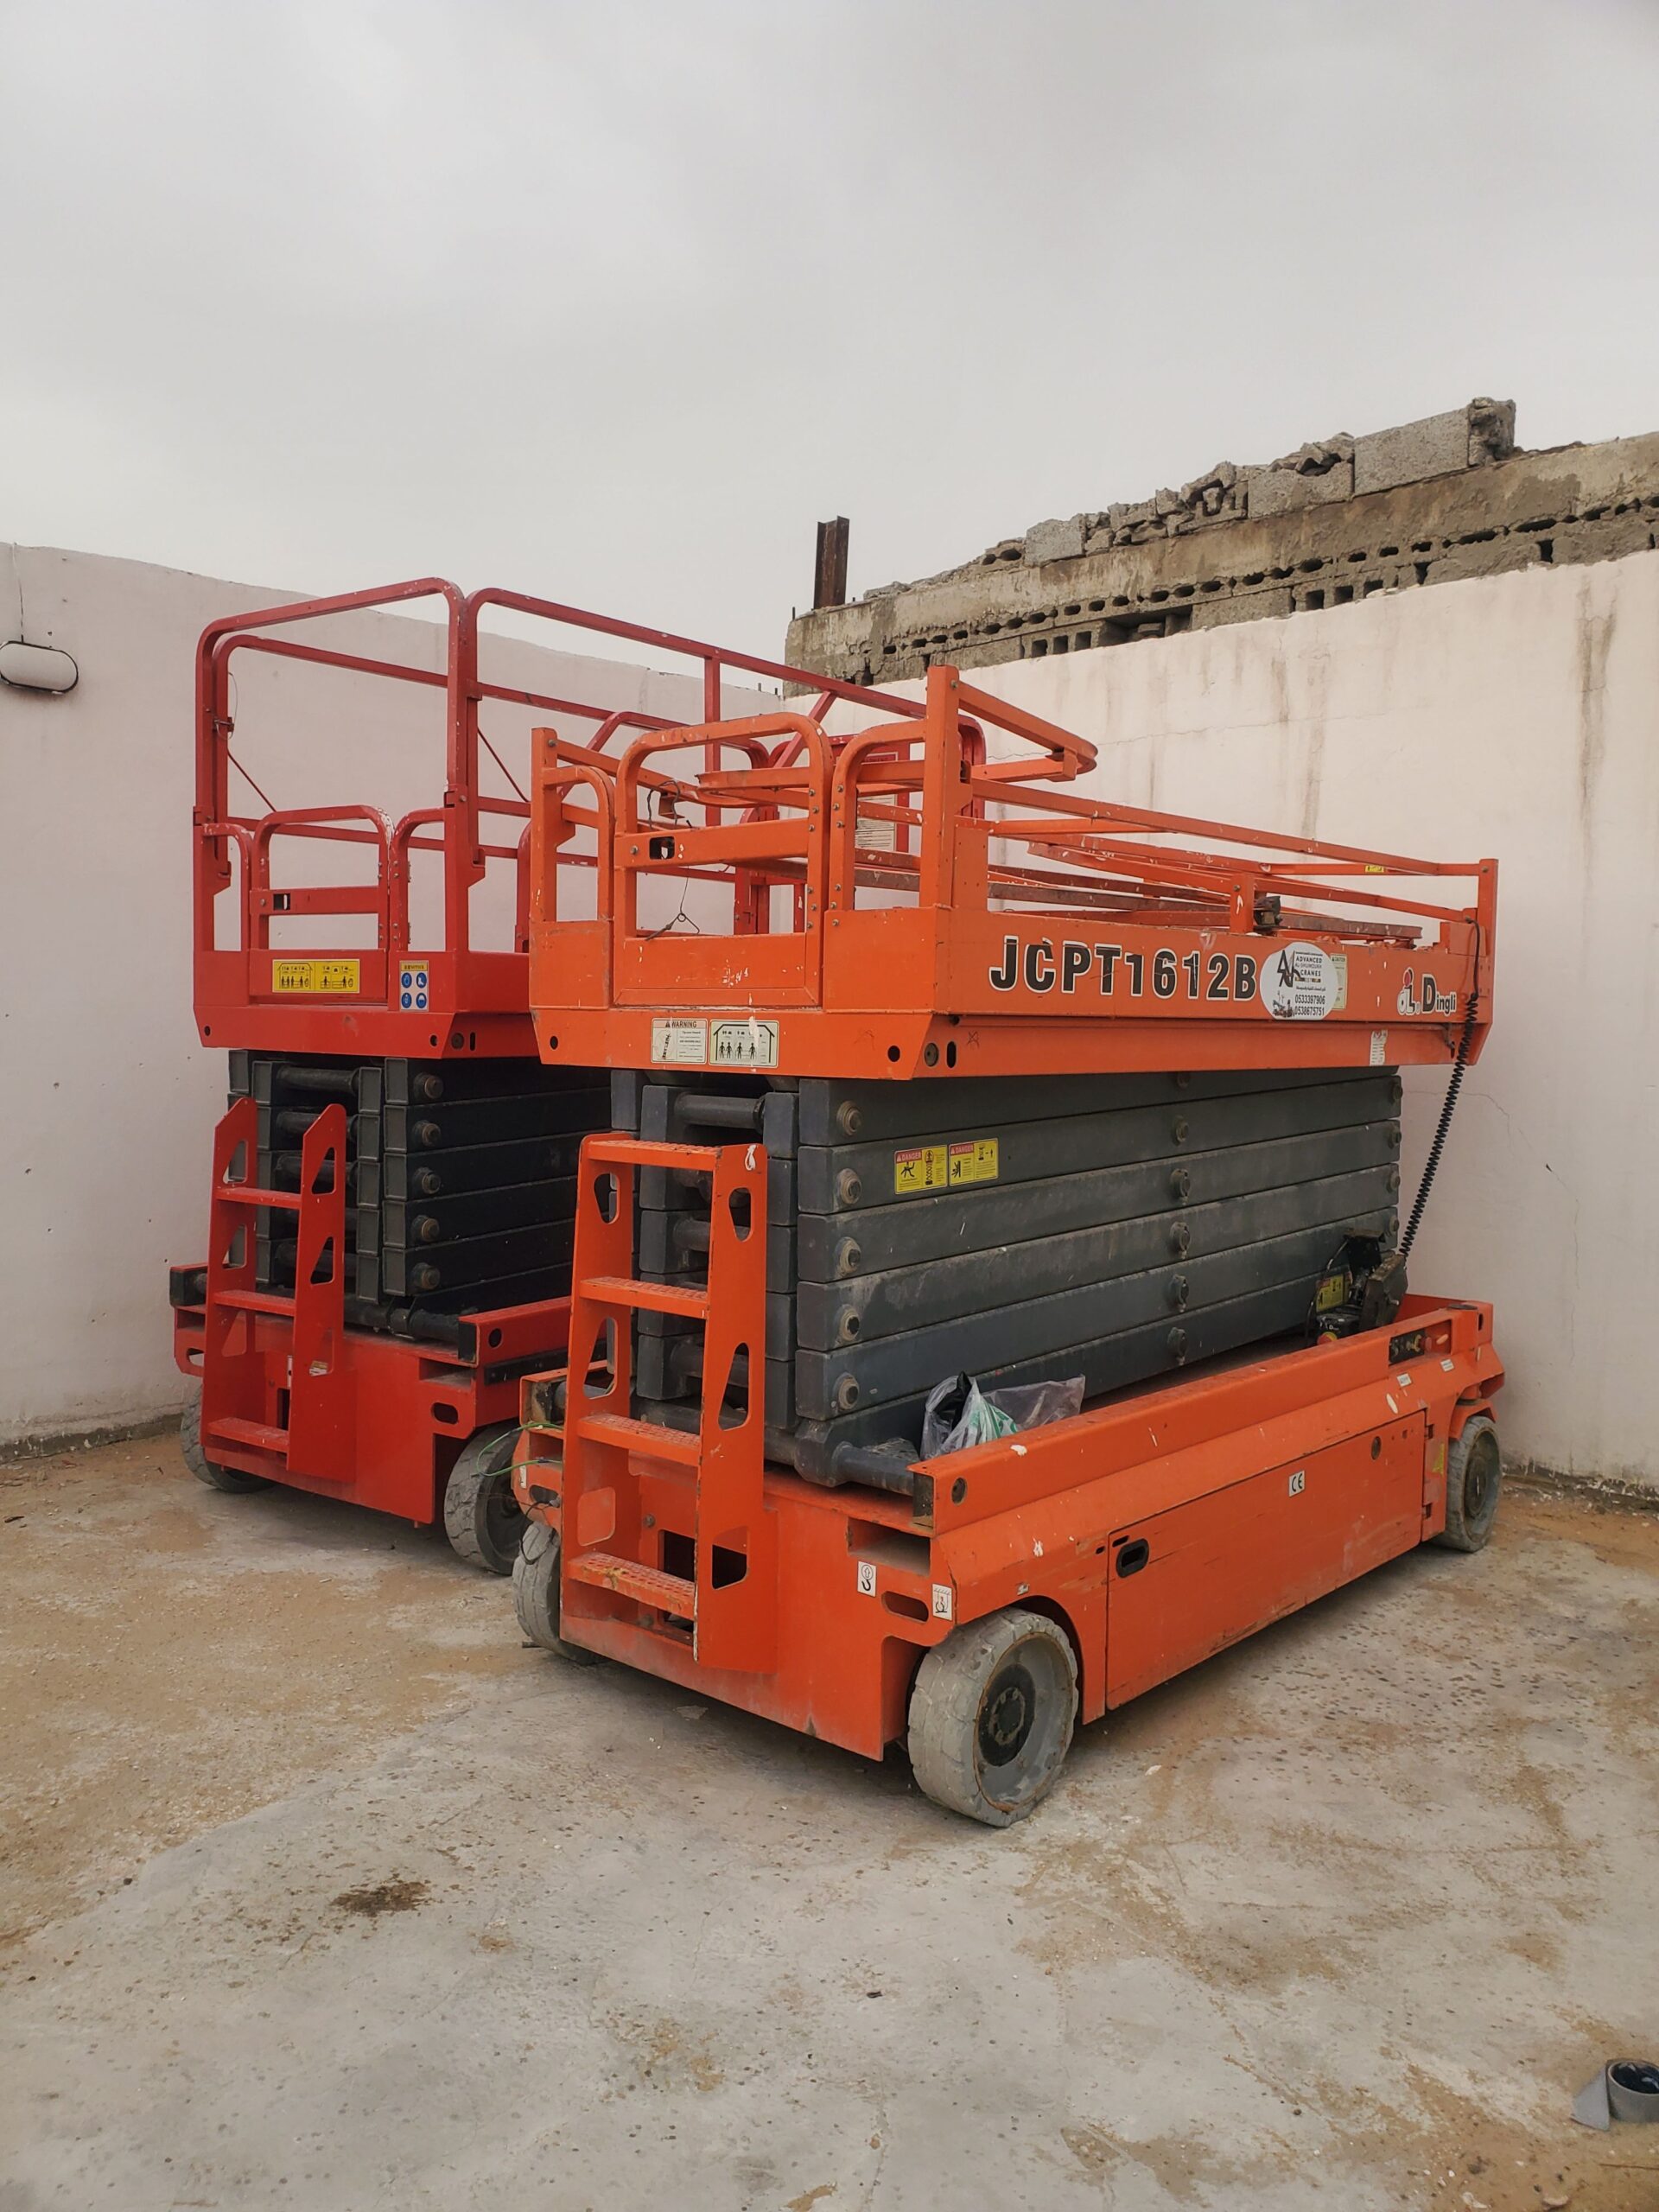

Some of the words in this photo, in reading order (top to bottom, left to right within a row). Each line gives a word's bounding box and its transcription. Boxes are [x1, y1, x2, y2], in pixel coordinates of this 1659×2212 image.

[988, 935, 1257, 1001] JCPT1612B
[1295, 995, 1325, 1004] 0533397906
[955, 1143, 974, 1153] DANGER
[902, 1152, 921, 1161] DANGER
[1292, 1473, 1302, 1492] CE
